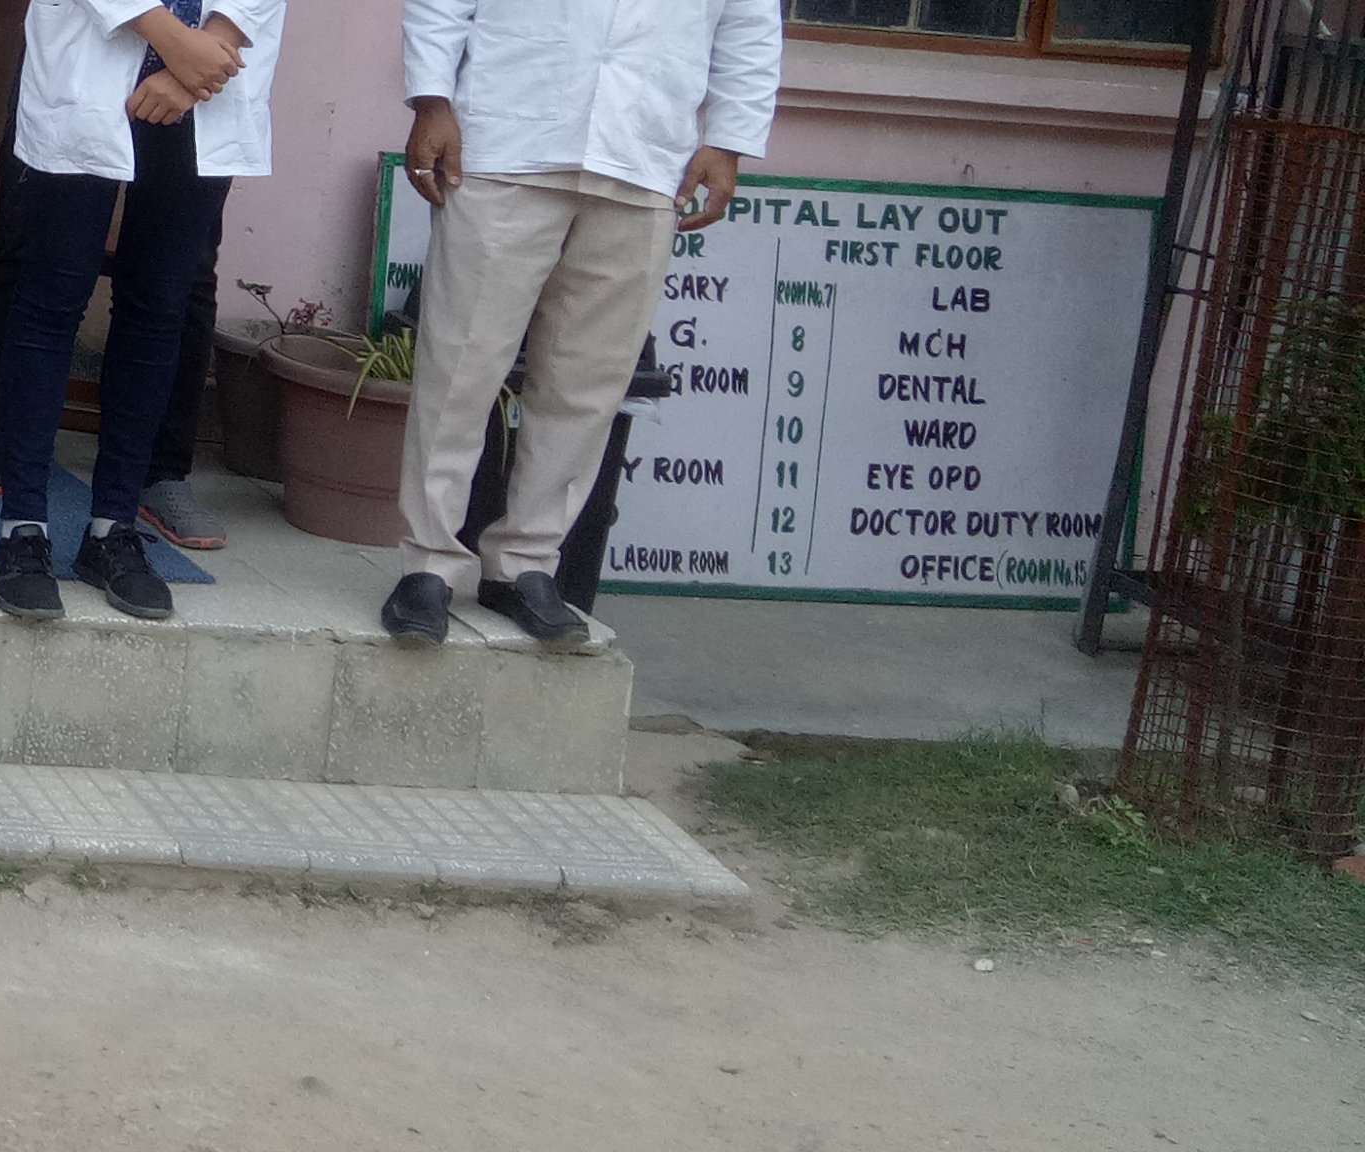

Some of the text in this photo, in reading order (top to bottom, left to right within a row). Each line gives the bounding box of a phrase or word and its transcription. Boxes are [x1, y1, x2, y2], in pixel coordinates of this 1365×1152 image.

[678, 196, 1008, 236] OPITAL LAY OUT
[825, 239, 1005, 271] FIRST FLOOR
[932, 285, 991, 313] LAB
[791, 325, 806, 352] 8
[898, 327, 968, 360] MCH
[690, 366, 750, 396] ROOM
[787, 369, 805, 398] 9
[878, 373, 987, 405] DENTAL
[776, 415, 804, 445] 10
[903, 418, 978, 450] WARD
[653, 456, 725, 487] ROOM
[775, 460, 800, 490] 11
[867, 463, 982, 492] EYE OPD
[771, 505, 797, 534] 12
[850, 507, 1104, 540] DOCTOR DUTY ROOM
[609, 544, 730, 576] LABOUR ROOM
[767, 550, 794, 576] 13
[899, 553, 995, 583] OFFICE
